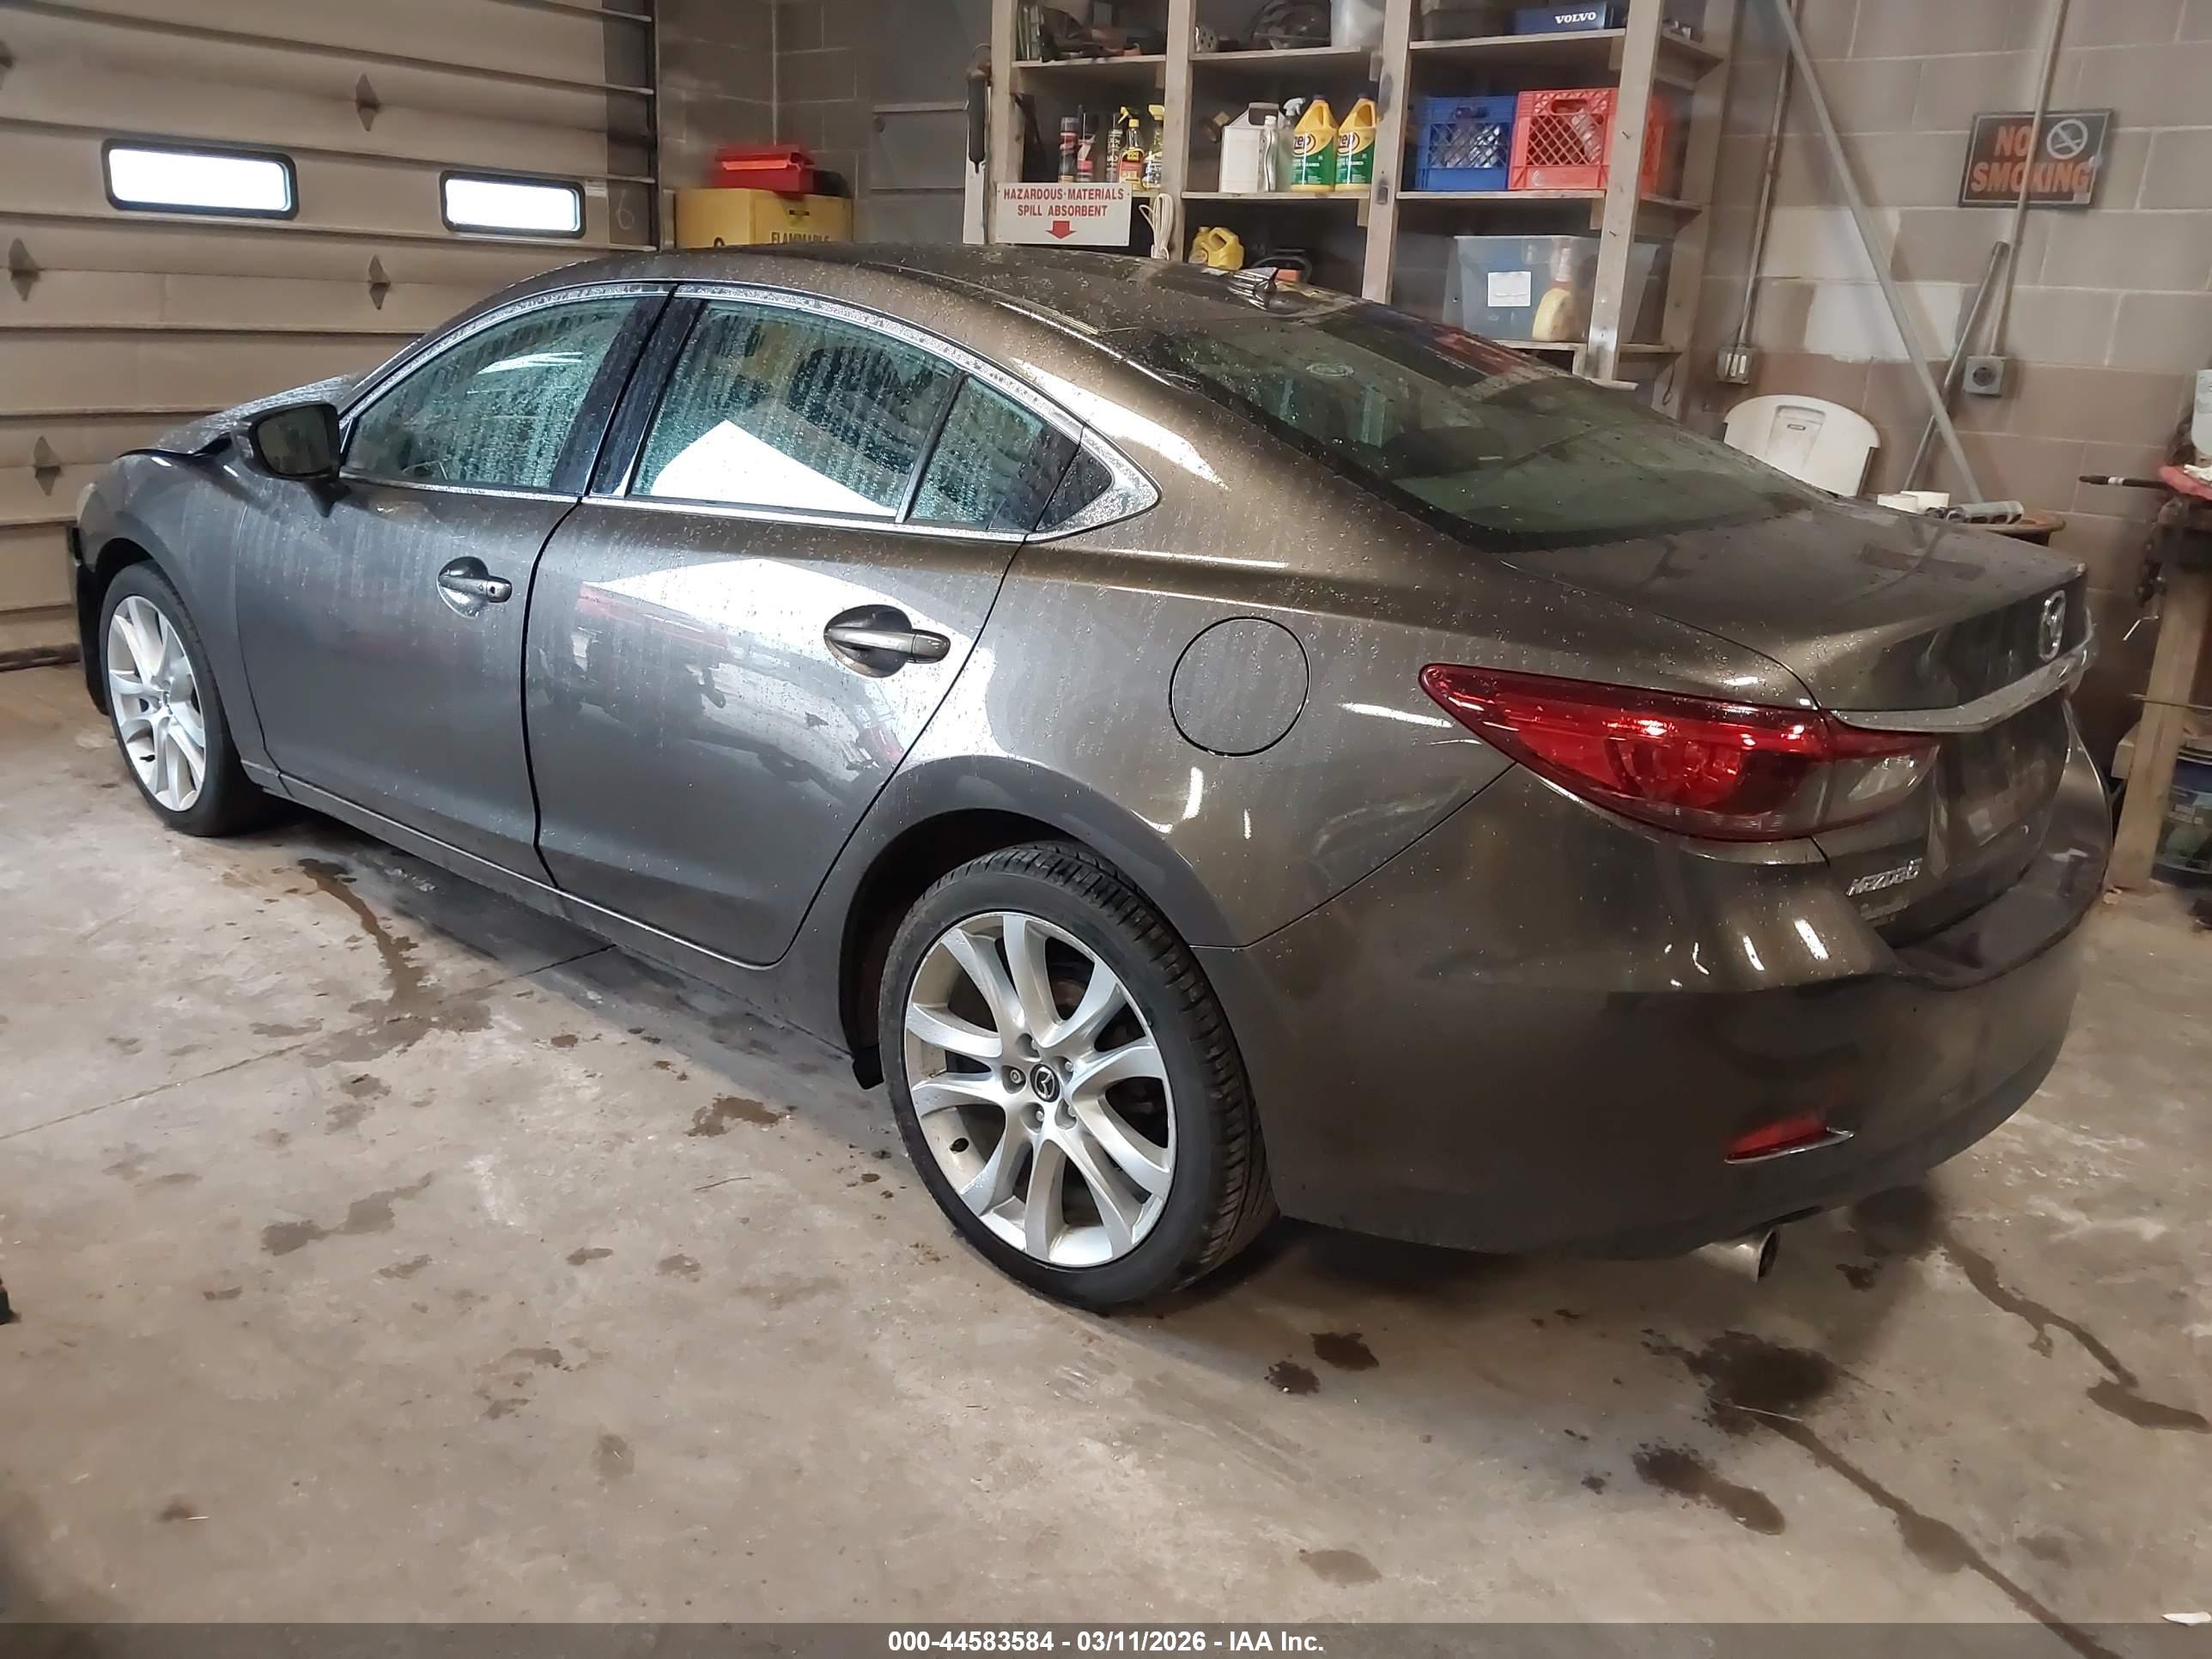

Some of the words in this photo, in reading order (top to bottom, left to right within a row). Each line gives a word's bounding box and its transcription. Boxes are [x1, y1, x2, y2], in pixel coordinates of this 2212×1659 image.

[1554, 11, 1597, 25] VOLVO
[1994, 125, 2034, 157] NO
[1970, 161, 2092, 192] SMOKING
[1004, 188, 1063, 200] HAZARDOUS
[1067, 188, 1124, 200] MATERIALS
[1018, 204, 1042, 216] SPILL
[1048, 204, 1108, 216] ABSORBENT
